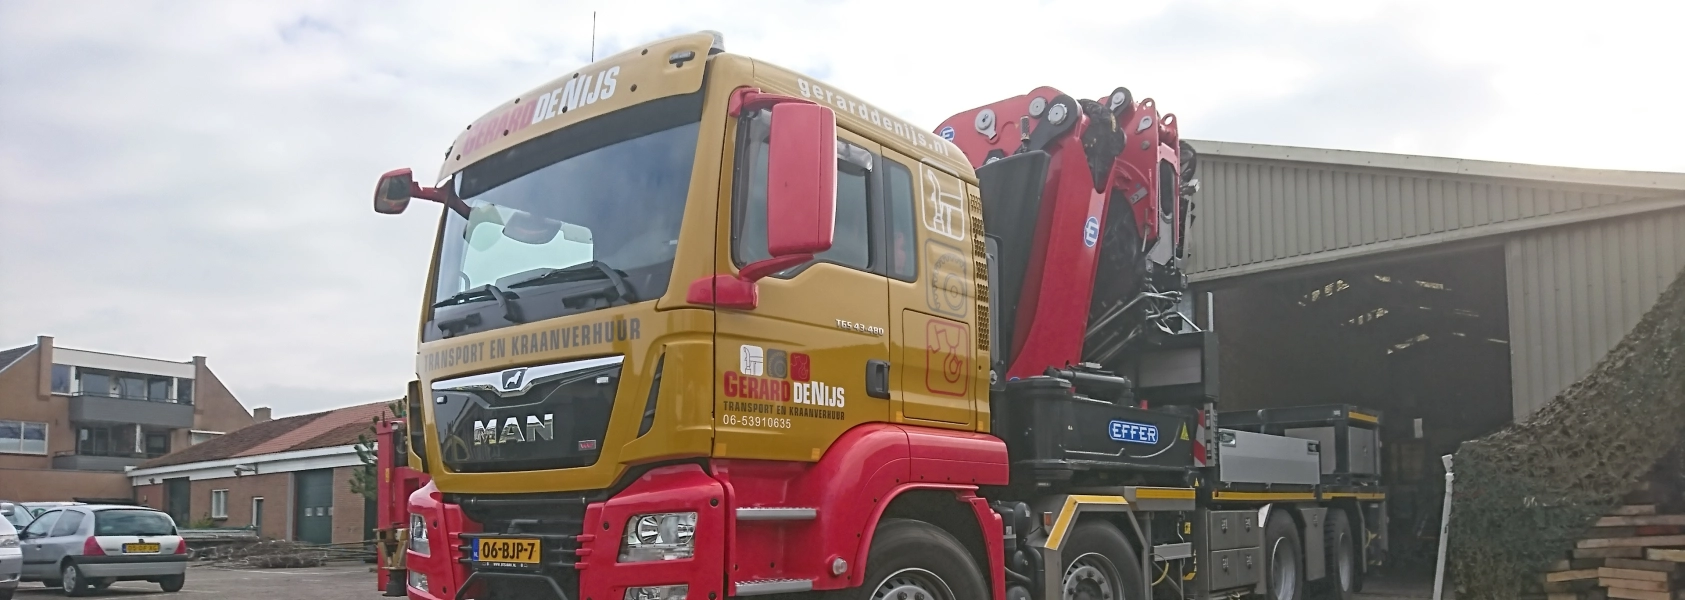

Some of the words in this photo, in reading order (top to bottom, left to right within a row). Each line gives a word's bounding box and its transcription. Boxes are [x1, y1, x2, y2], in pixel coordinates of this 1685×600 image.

[797, 77, 949, 157] gerarddenijs.nl
[835, 318, 852, 329] TGS
[424, 341, 485, 372] TRANSPORT
[490, 335, 506, 360] EN
[511, 317, 641, 352] KRAANVERHUUR
[723, 370, 791, 403] GERARD
[723, 400, 774, 415] TRANSPORT
[776, 405, 787, 416] EN
[789, 406, 845, 421] KRAANVERHUUR
[473, 413, 554, 446] MAN
[722, 414, 791, 429] 06-53910635
[1112, 423, 1156, 442] EFFER
[482, 541, 535, 560] 06-BJP-7
